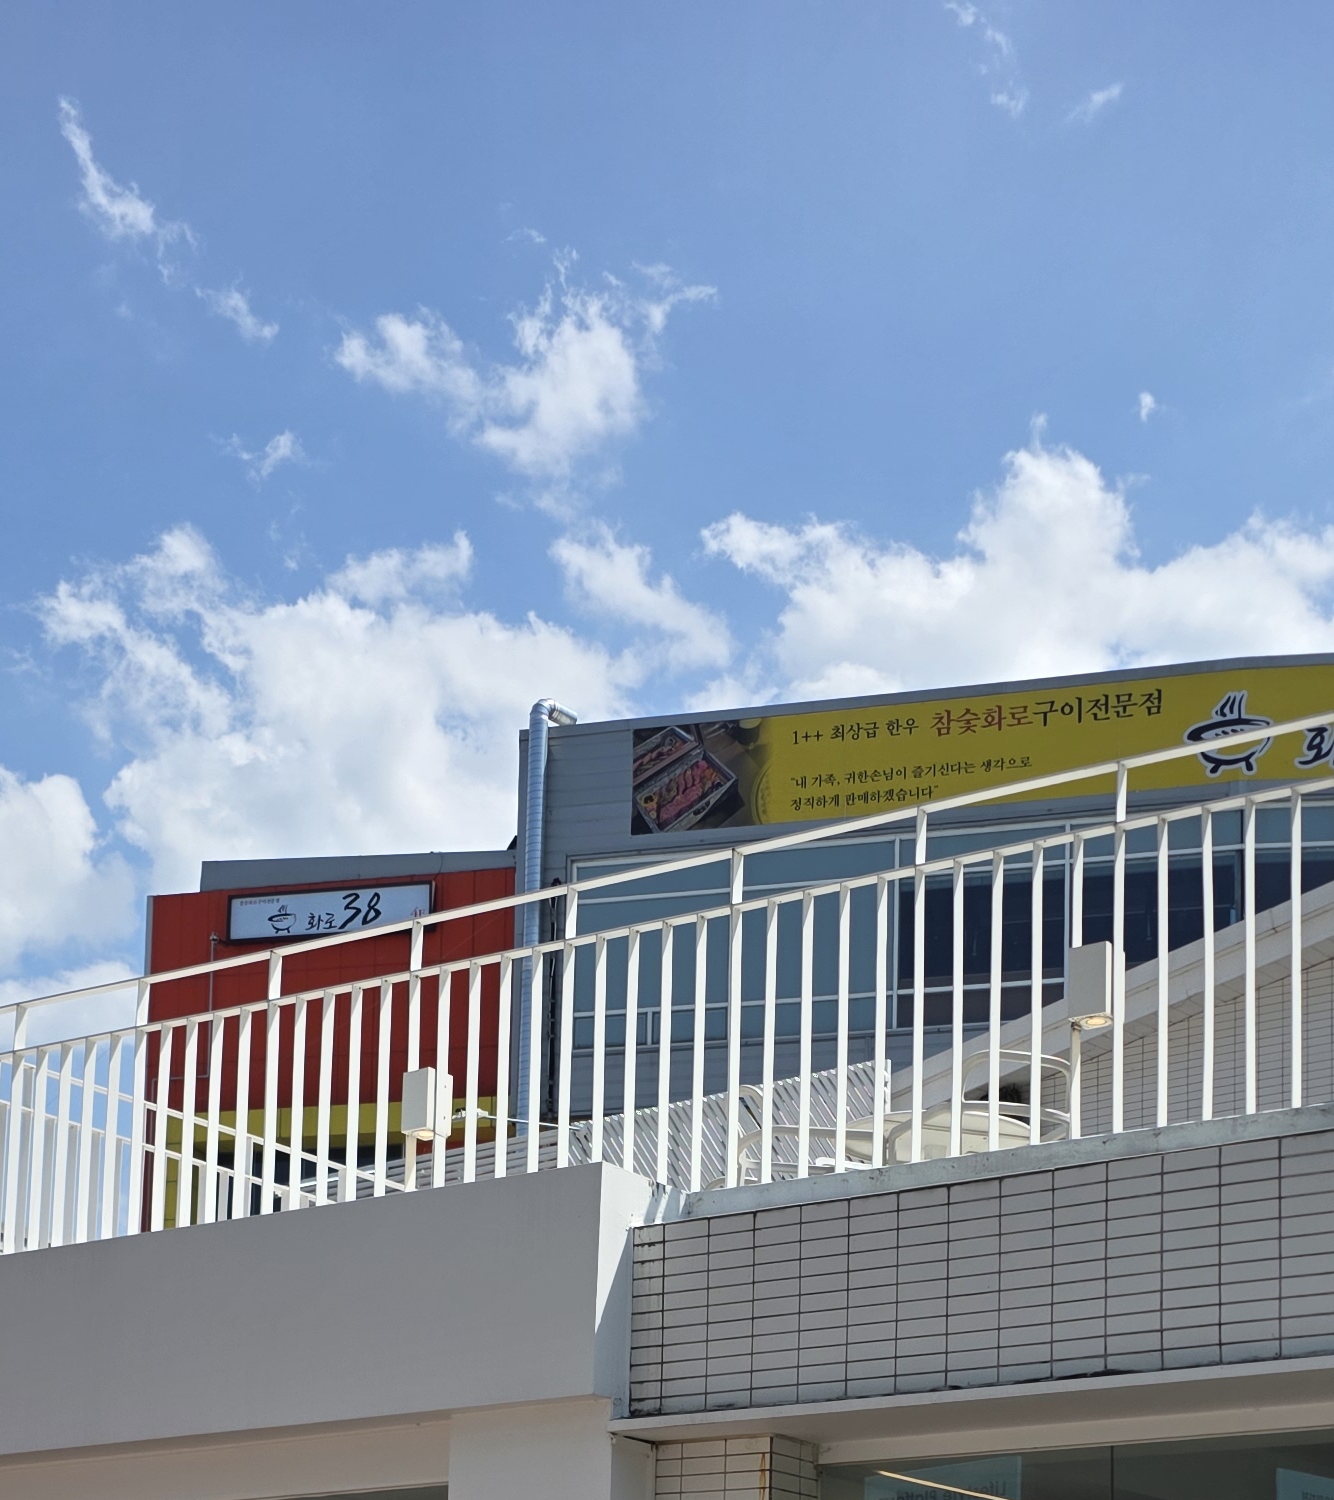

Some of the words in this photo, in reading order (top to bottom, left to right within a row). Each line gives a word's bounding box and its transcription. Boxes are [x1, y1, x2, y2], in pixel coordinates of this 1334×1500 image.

[791, 729, 824, 746] 1++
[829, 721, 881, 742] 최상급
[885, 717, 920, 738] 한우
[929, 688, 1164, 738] 참숯화로구이전문점
[811, 772, 841, 789] 가족,
[844, 765, 908, 786] 귀한손님이
[910, 759, 977, 780] 즐기신다는
[980, 755, 1034, 774] 생각으로
[789, 793, 841, 812] 정직하게
